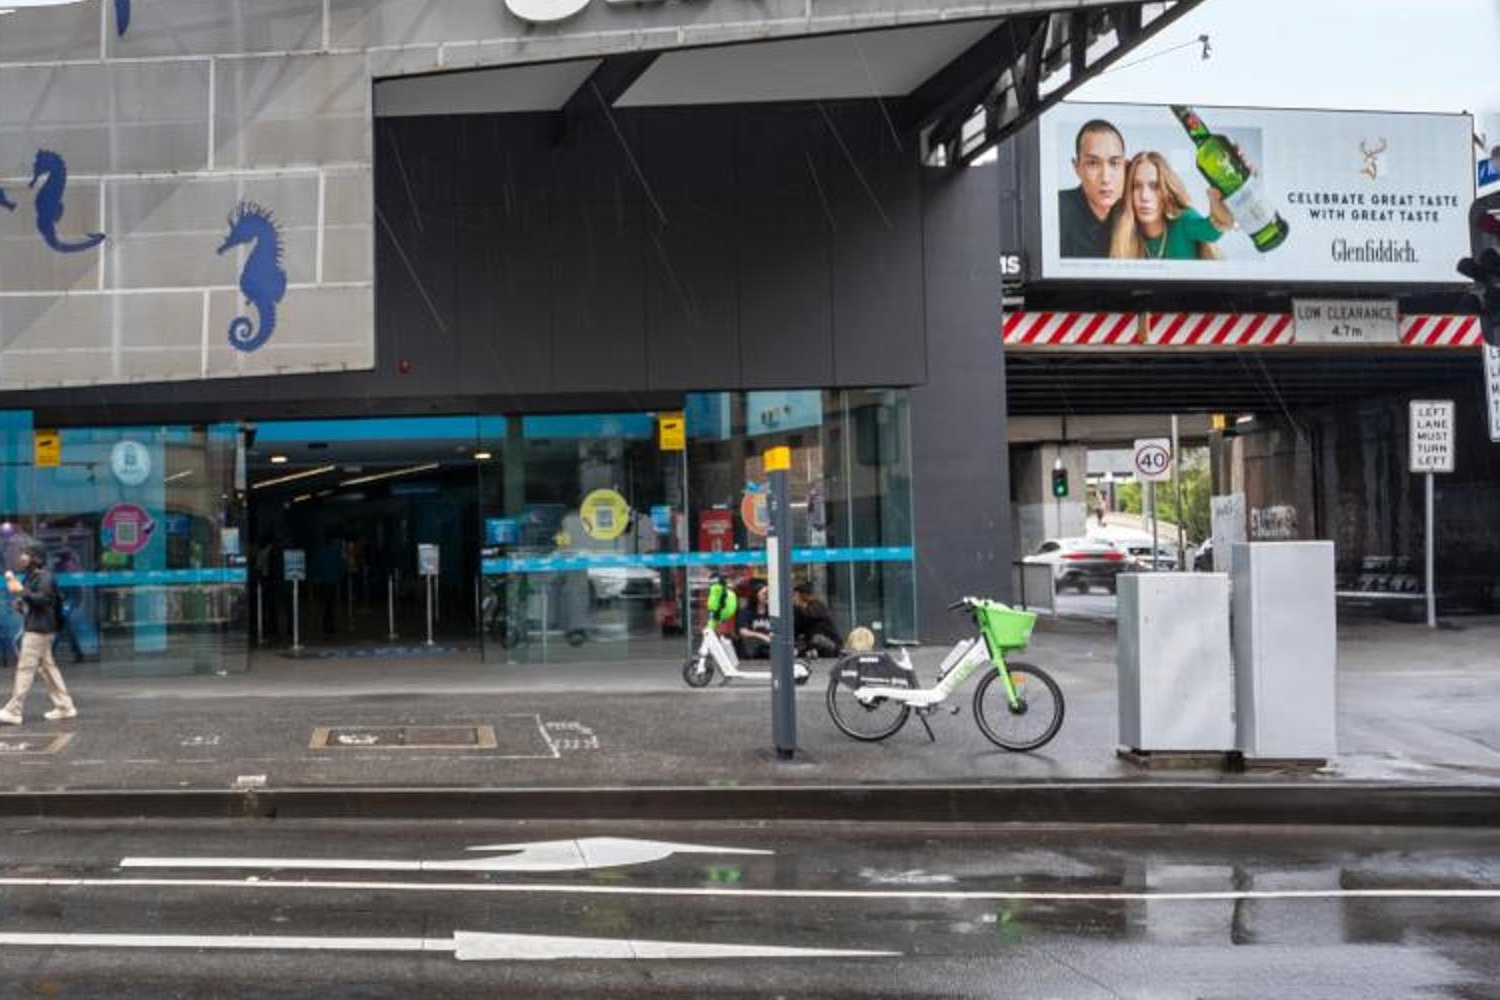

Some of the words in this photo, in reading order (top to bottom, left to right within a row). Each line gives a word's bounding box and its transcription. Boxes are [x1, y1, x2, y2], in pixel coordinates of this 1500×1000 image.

[1287, 192, 1365, 205] CELEBRATE
[1372, 194, 1414, 206] GREAT
[1420, 195, 1459, 207] TASTE
[1310, 209, 1346, 220] WITH
[1352, 210, 1395, 221] GREAT
[1401, 211, 1440, 222] TASTE
[1297, 306, 1320, 319] LOW
[1327, 306, 1395, 320] CLEARANCE
[1331, 324, 1363, 337] 4.7m
[1418, 407, 1446, 417] LEFT
[1417, 419, 1447, 429] LANE
[1417, 431, 1447, 440] MUST
[1418, 443, 1447, 453] TURN
[1140, 452, 1166, 468] 40
[1418, 455, 1446, 465] LEFT
